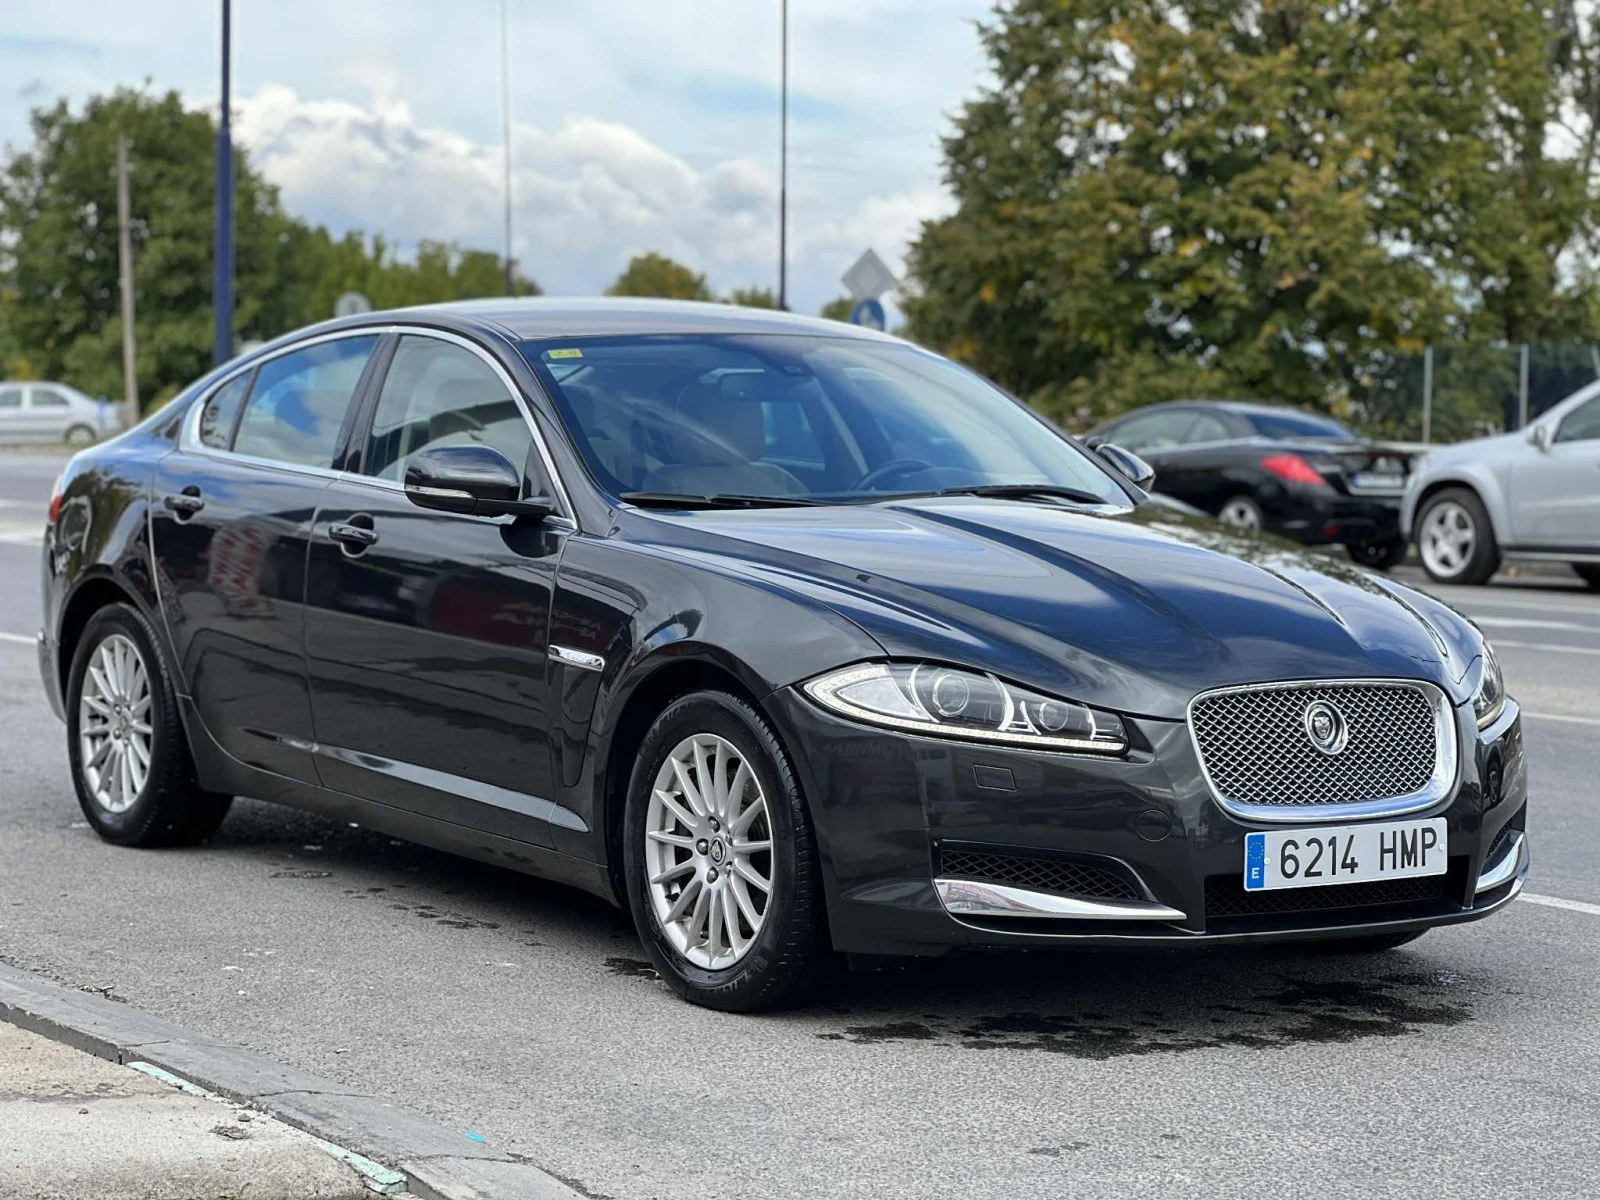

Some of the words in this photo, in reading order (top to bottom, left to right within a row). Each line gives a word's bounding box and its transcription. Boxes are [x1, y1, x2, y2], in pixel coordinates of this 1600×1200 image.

[1280, 834, 1359, 879] 6214
[1379, 827, 1437, 871] HMP
[1251, 867, 1260, 879] E
